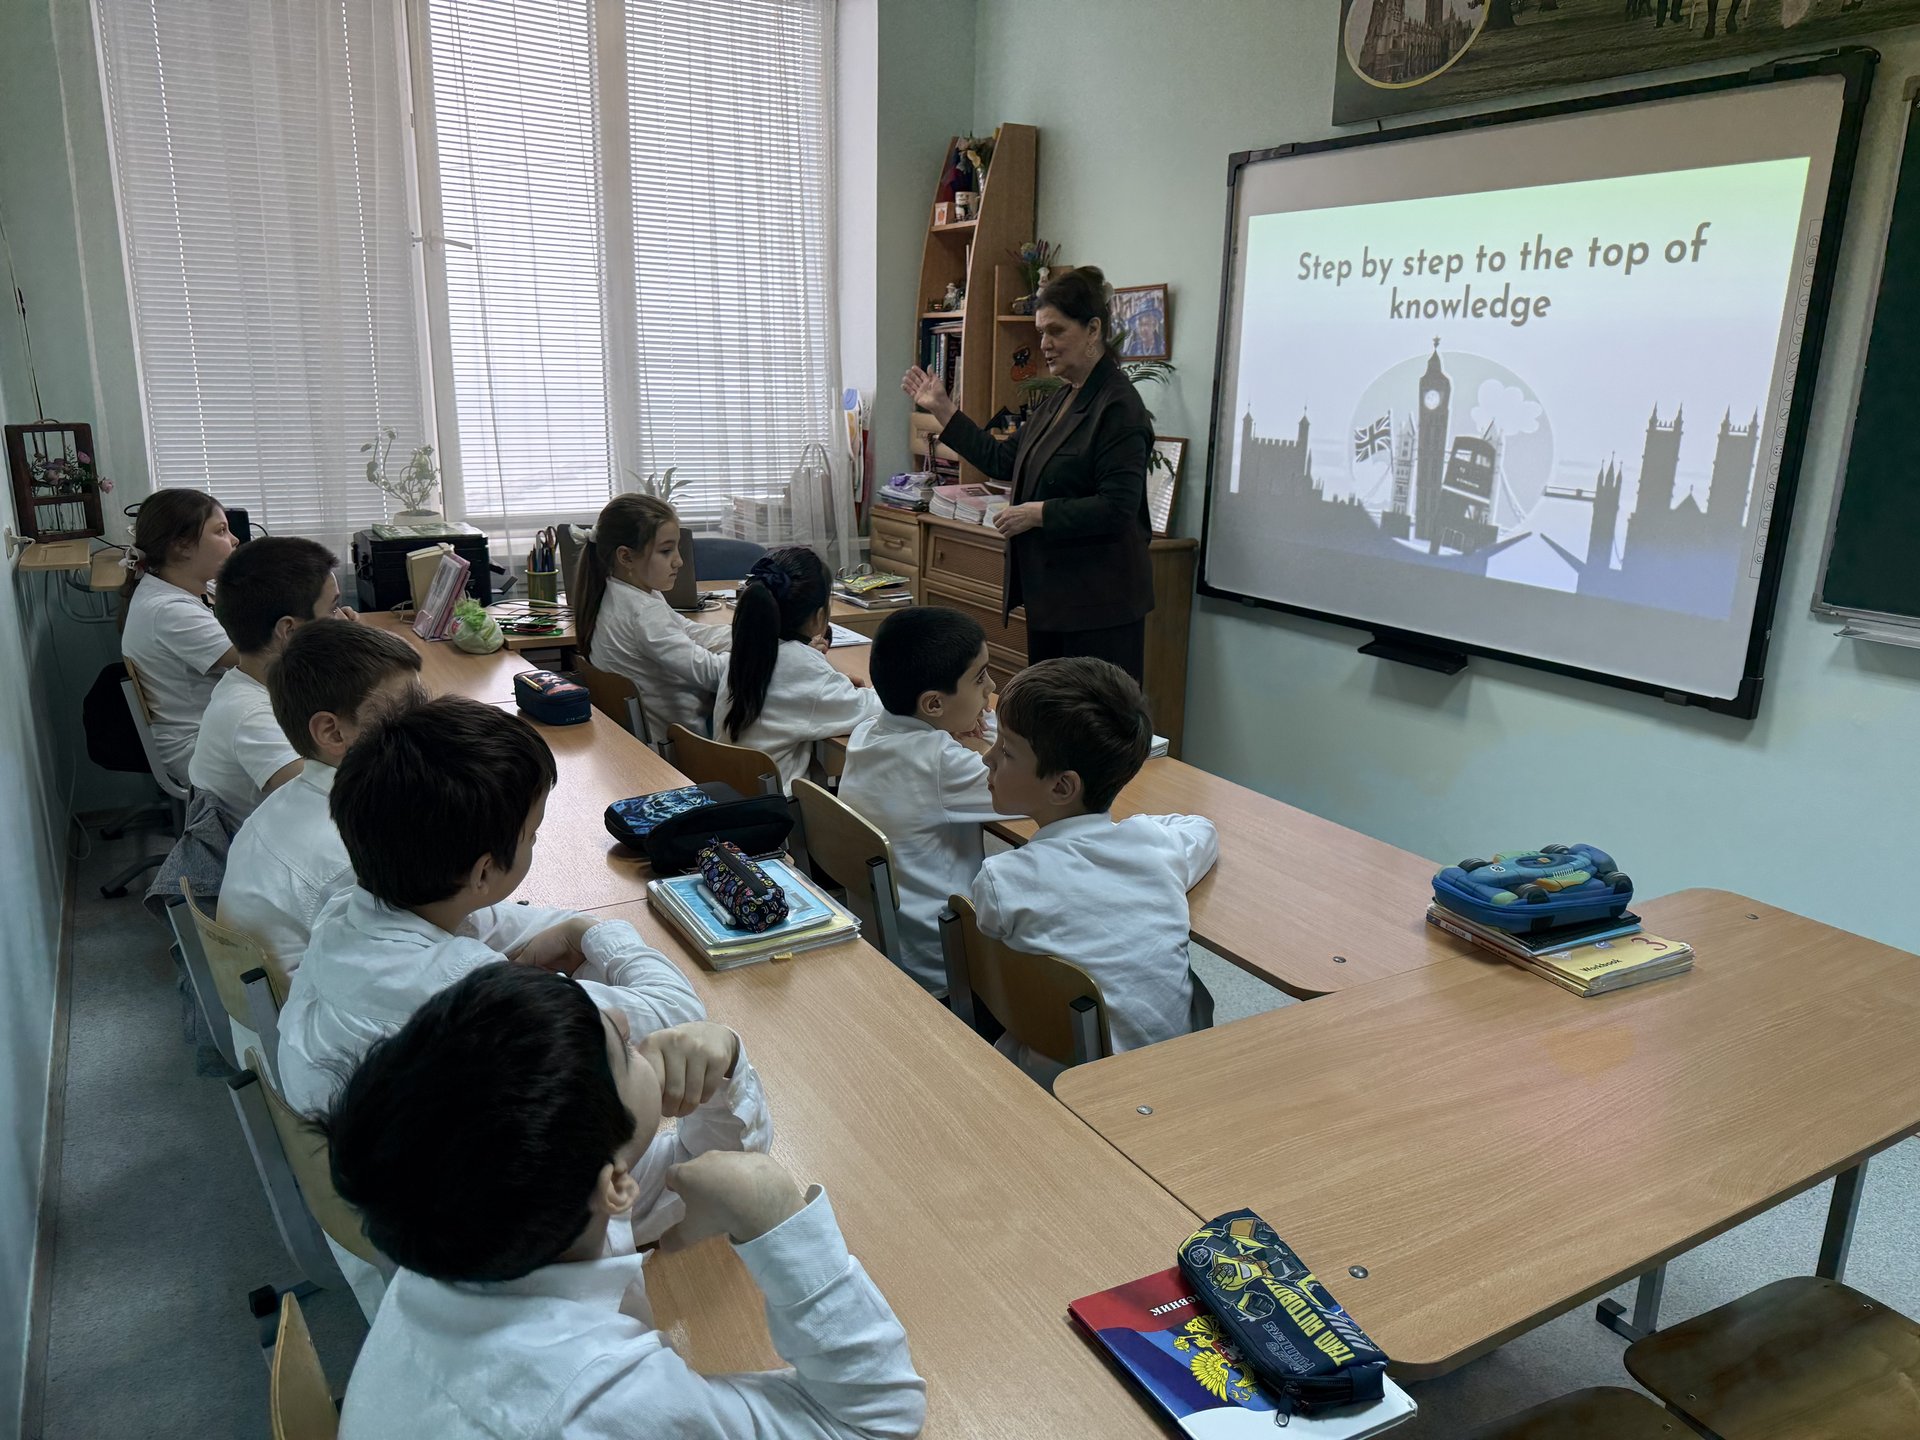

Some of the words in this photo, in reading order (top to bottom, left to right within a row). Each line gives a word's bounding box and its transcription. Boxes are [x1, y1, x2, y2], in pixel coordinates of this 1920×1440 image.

[1297, 251, 1353, 287] Step
[1361, 246, 1394, 285] by
[1402, 248, 1465, 283] step
[1475, 245, 1507, 274] to
[1520, 233, 1574, 271] the
[1588, 236, 1650, 276] top
[1664, 221, 1712, 263] of
[1389, 282, 1552, 327] knowledge
[1630, 936, 1668, 951] 3
[1579, 958, 1623, 973] Workbook
[1313, 1330, 1356, 1367] TEAM
